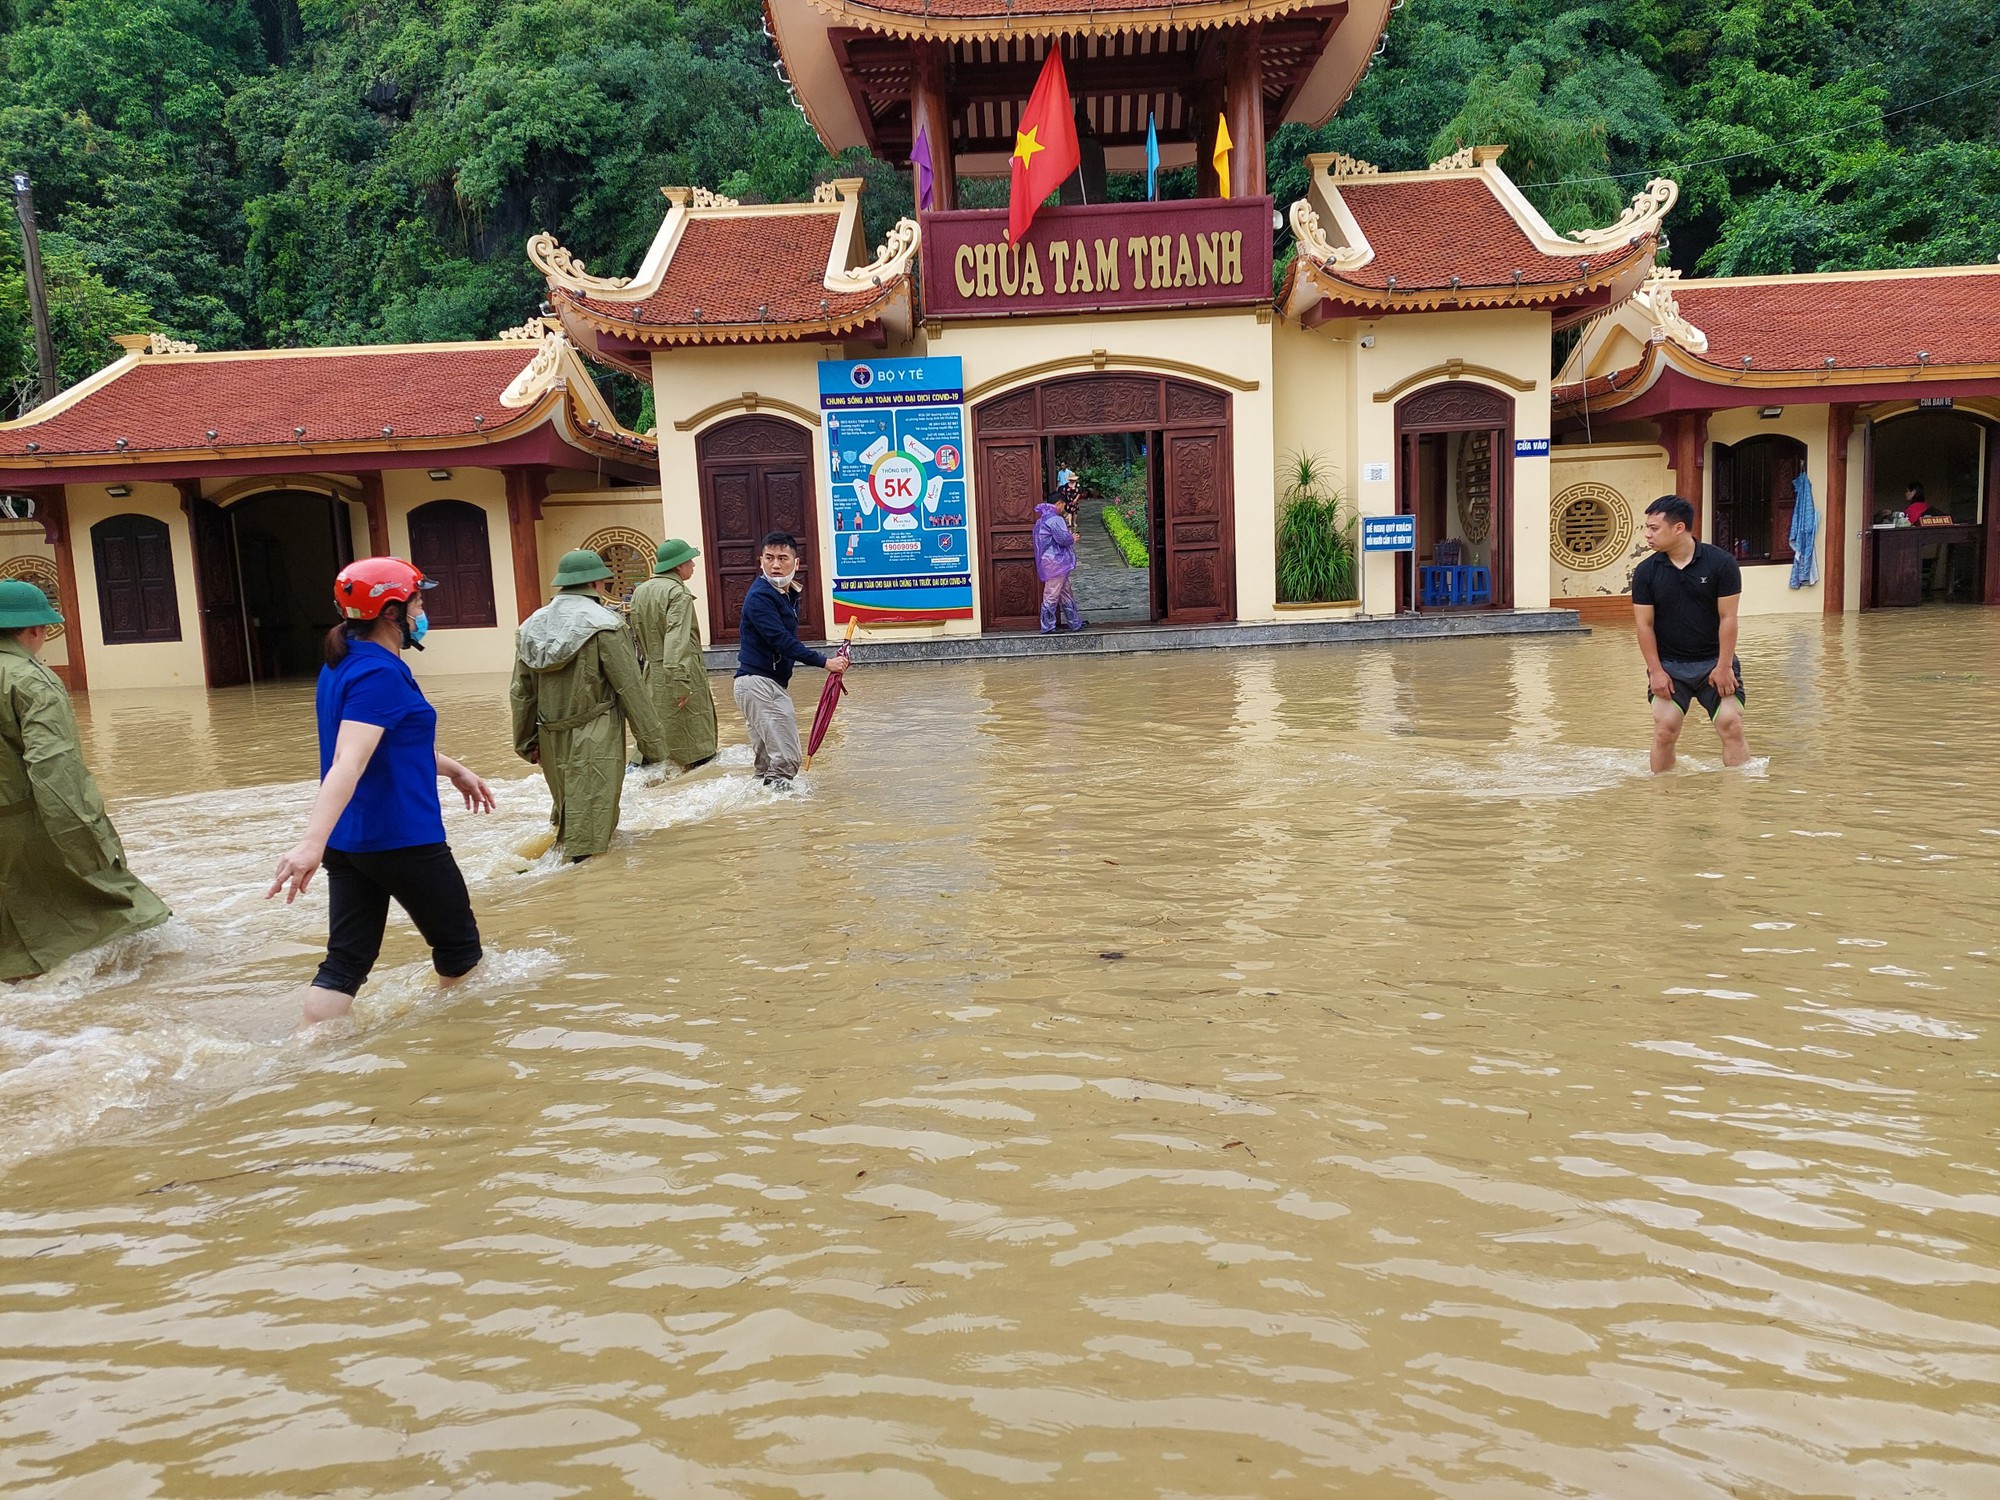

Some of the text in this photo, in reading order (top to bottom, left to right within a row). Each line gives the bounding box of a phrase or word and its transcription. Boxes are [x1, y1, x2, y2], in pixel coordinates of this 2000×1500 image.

[955, 228, 1244, 298] CHÙA TAM THANH
[878, 369, 895, 383] BỘ
[898, 370, 906, 380] Y
[826, 397, 846, 405] CHUNG
[847, 395, 863, 405] SỐNG
[865, 396, 874, 404] AN
[875, 394, 892, 404] TOÀN
[917, 394, 931, 403] DỊCH
[932, 392, 959, 402] COVID-19
[1533, 440, 1547, 450] VÀO
[884, 478, 913, 497] 5K
[884, 542, 919, 551] 19009095
